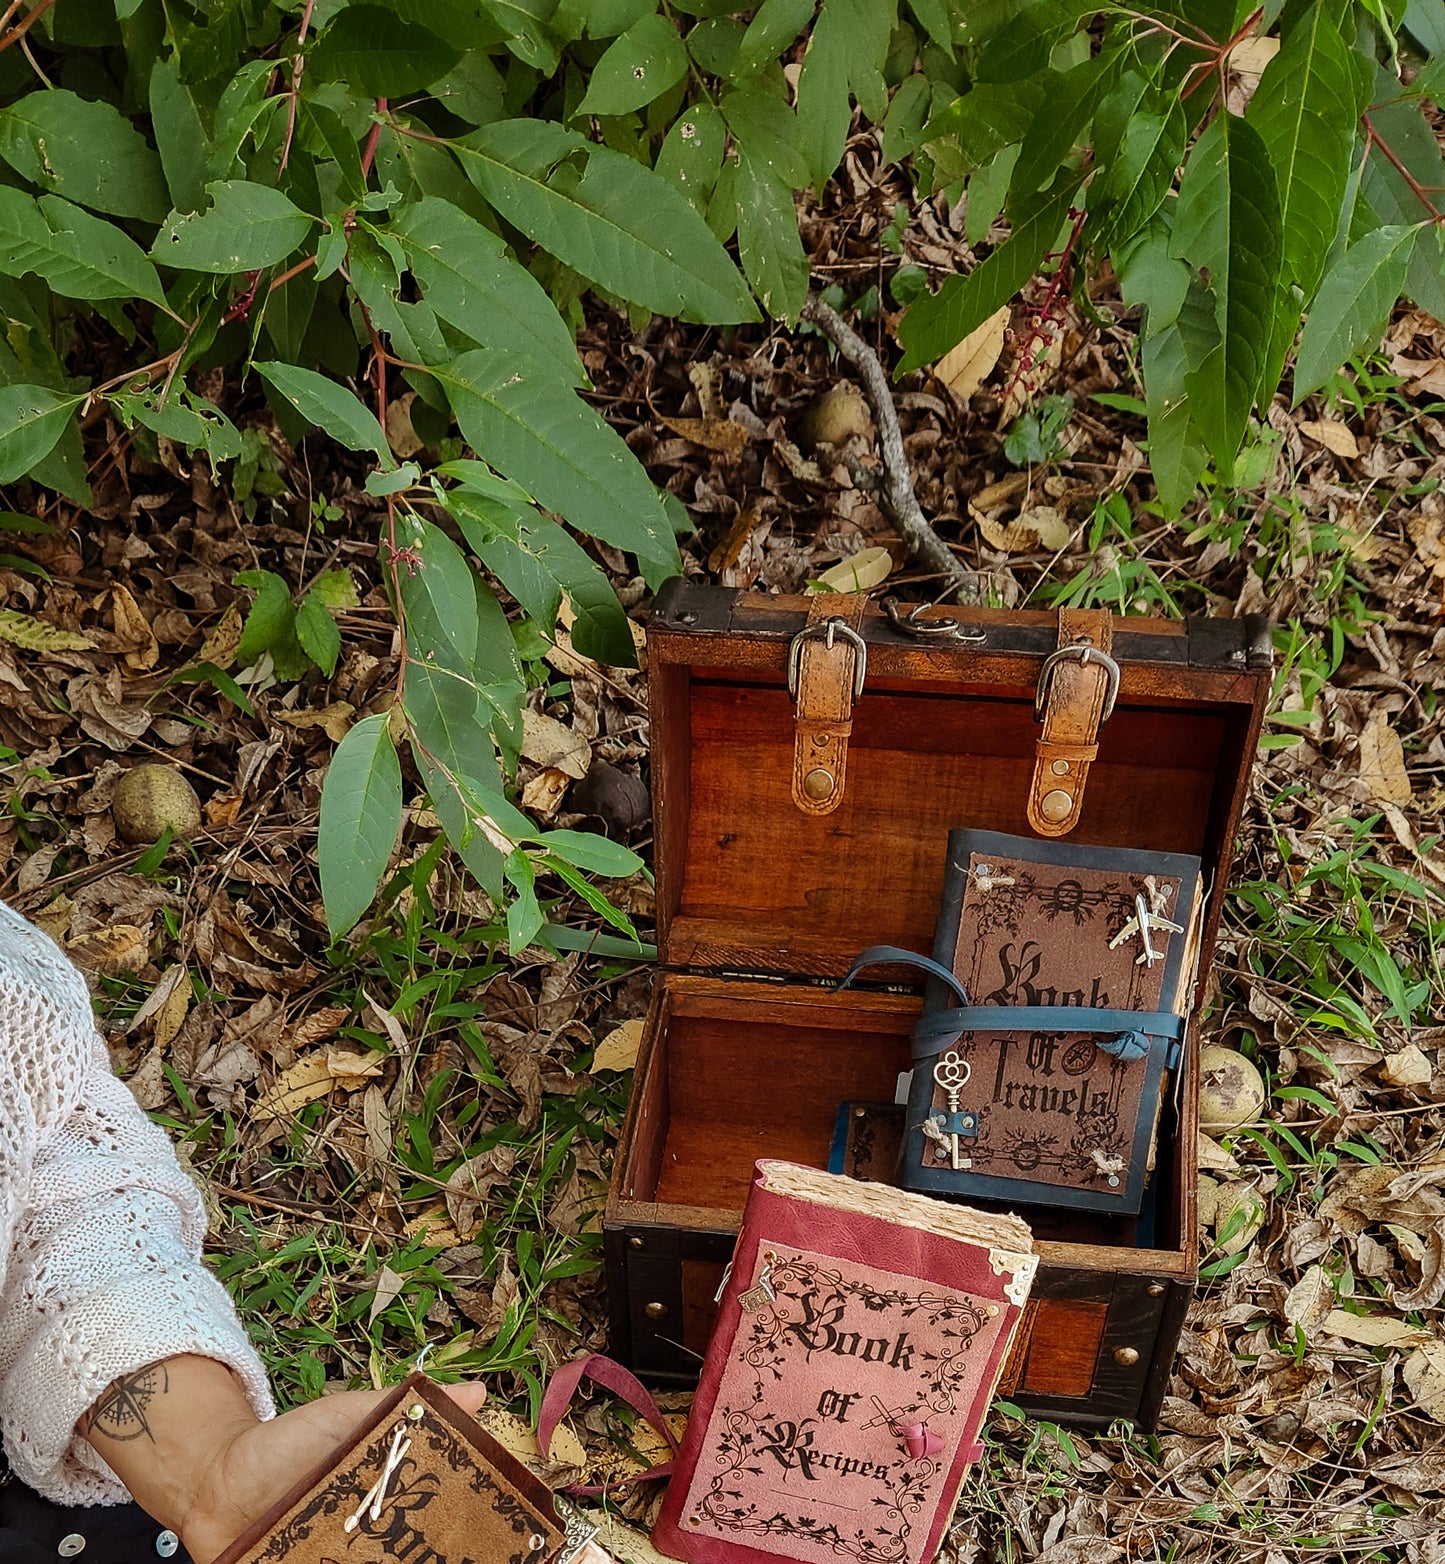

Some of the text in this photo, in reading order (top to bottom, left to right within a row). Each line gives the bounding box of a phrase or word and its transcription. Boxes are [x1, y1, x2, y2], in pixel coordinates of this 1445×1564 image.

[989, 1030, 1109, 1118] Travels
[782, 1290, 916, 1372] Book
[755, 1417, 890, 1484] Recipes
